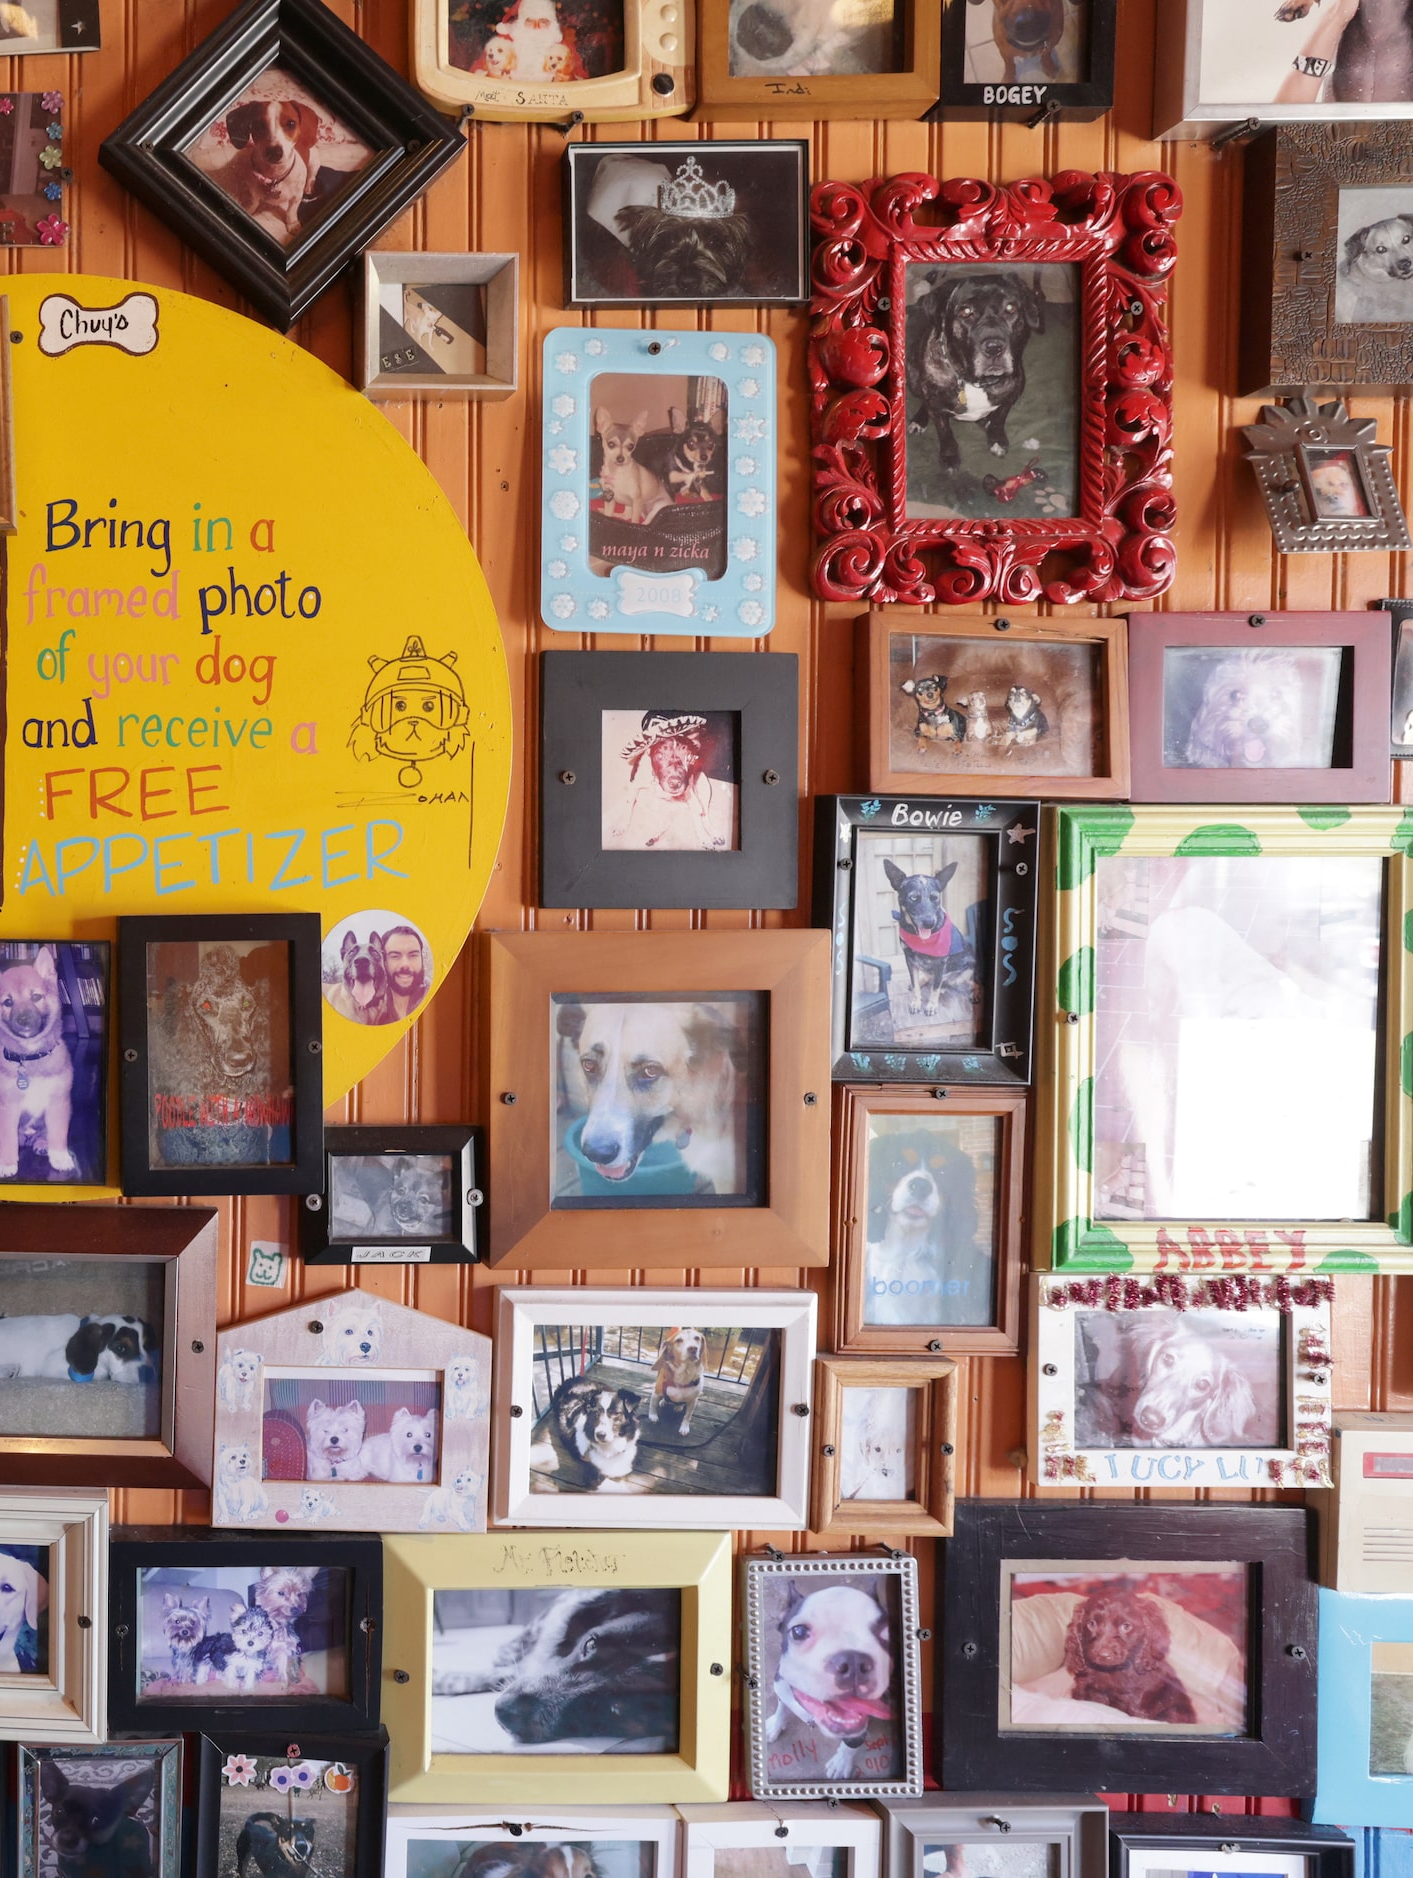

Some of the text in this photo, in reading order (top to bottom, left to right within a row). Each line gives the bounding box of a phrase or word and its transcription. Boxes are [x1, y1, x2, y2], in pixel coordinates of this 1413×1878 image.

[516, 91, 568, 105] SANTA
[983, 86, 1047, 105] BOGEY
[60, 308, 129, 339] Chuy's
[45, 498, 275, 577] Bring in a
[602, 541, 709, 564] maya n zicka
[22, 563, 321, 635] framed photo
[636, 587, 681, 603] 2008
[37, 629, 277, 705] of your dog
[22, 697, 319, 755] and receive a
[44, 765, 230, 821] FREE
[891, 803, 963, 828] Bowie
[18, 819, 410, 897] APPETIZER
[356, 1250, 423, 1259] JACK
[1153, 1227, 1307, 1273] ABBEY
[872, 1276, 970, 1297] boomer
